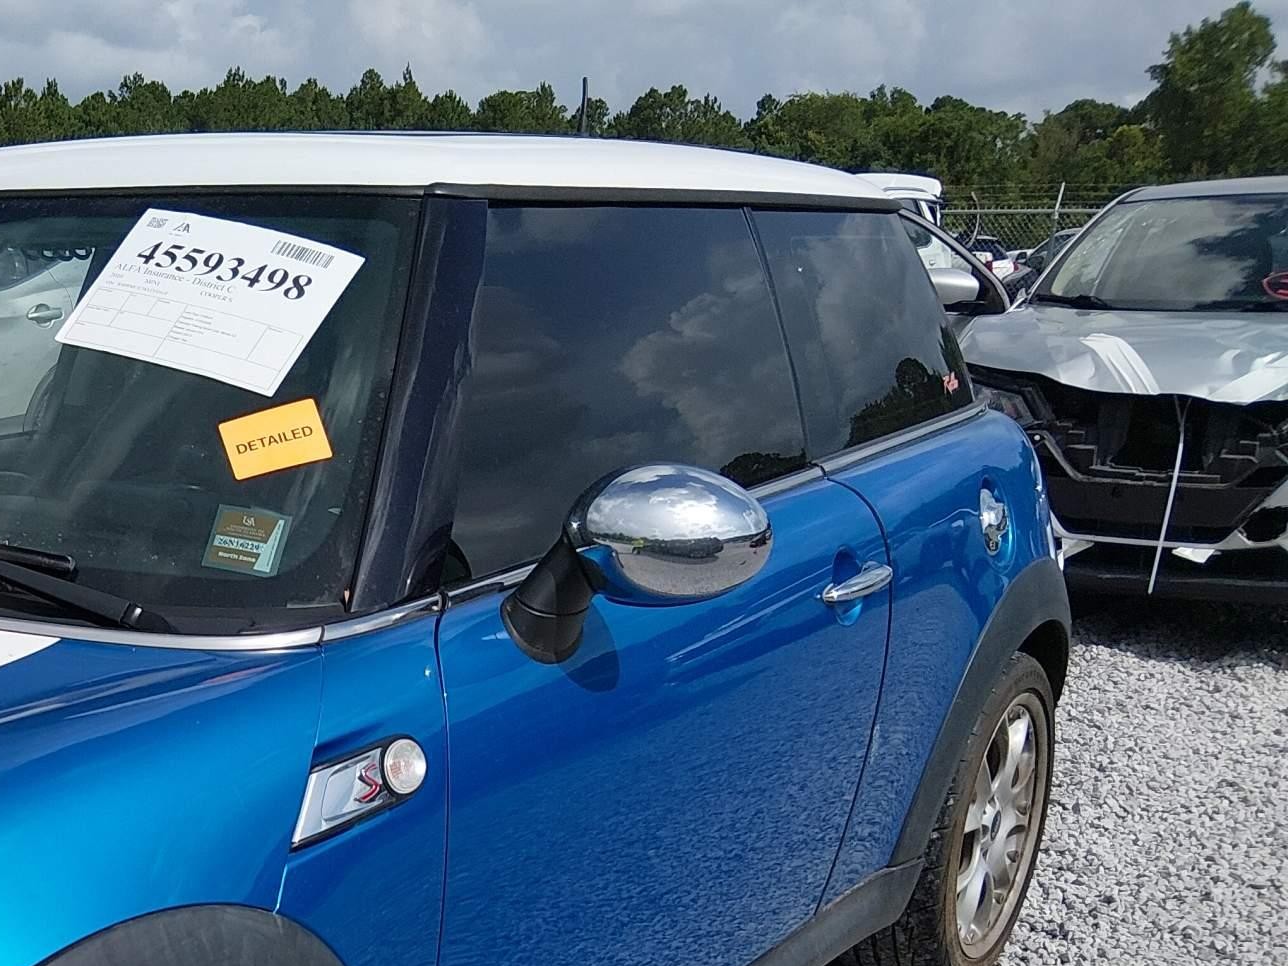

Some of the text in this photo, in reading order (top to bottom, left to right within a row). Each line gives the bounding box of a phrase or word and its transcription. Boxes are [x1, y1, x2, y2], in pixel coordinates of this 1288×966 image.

[115, 262, 142, 273] ALFA
[143, 266, 185, 282] Insurance
[192, 277, 226, 292] District
[136, 241, 313, 300] 45593498
[235, 425, 314, 455] DETAILED
